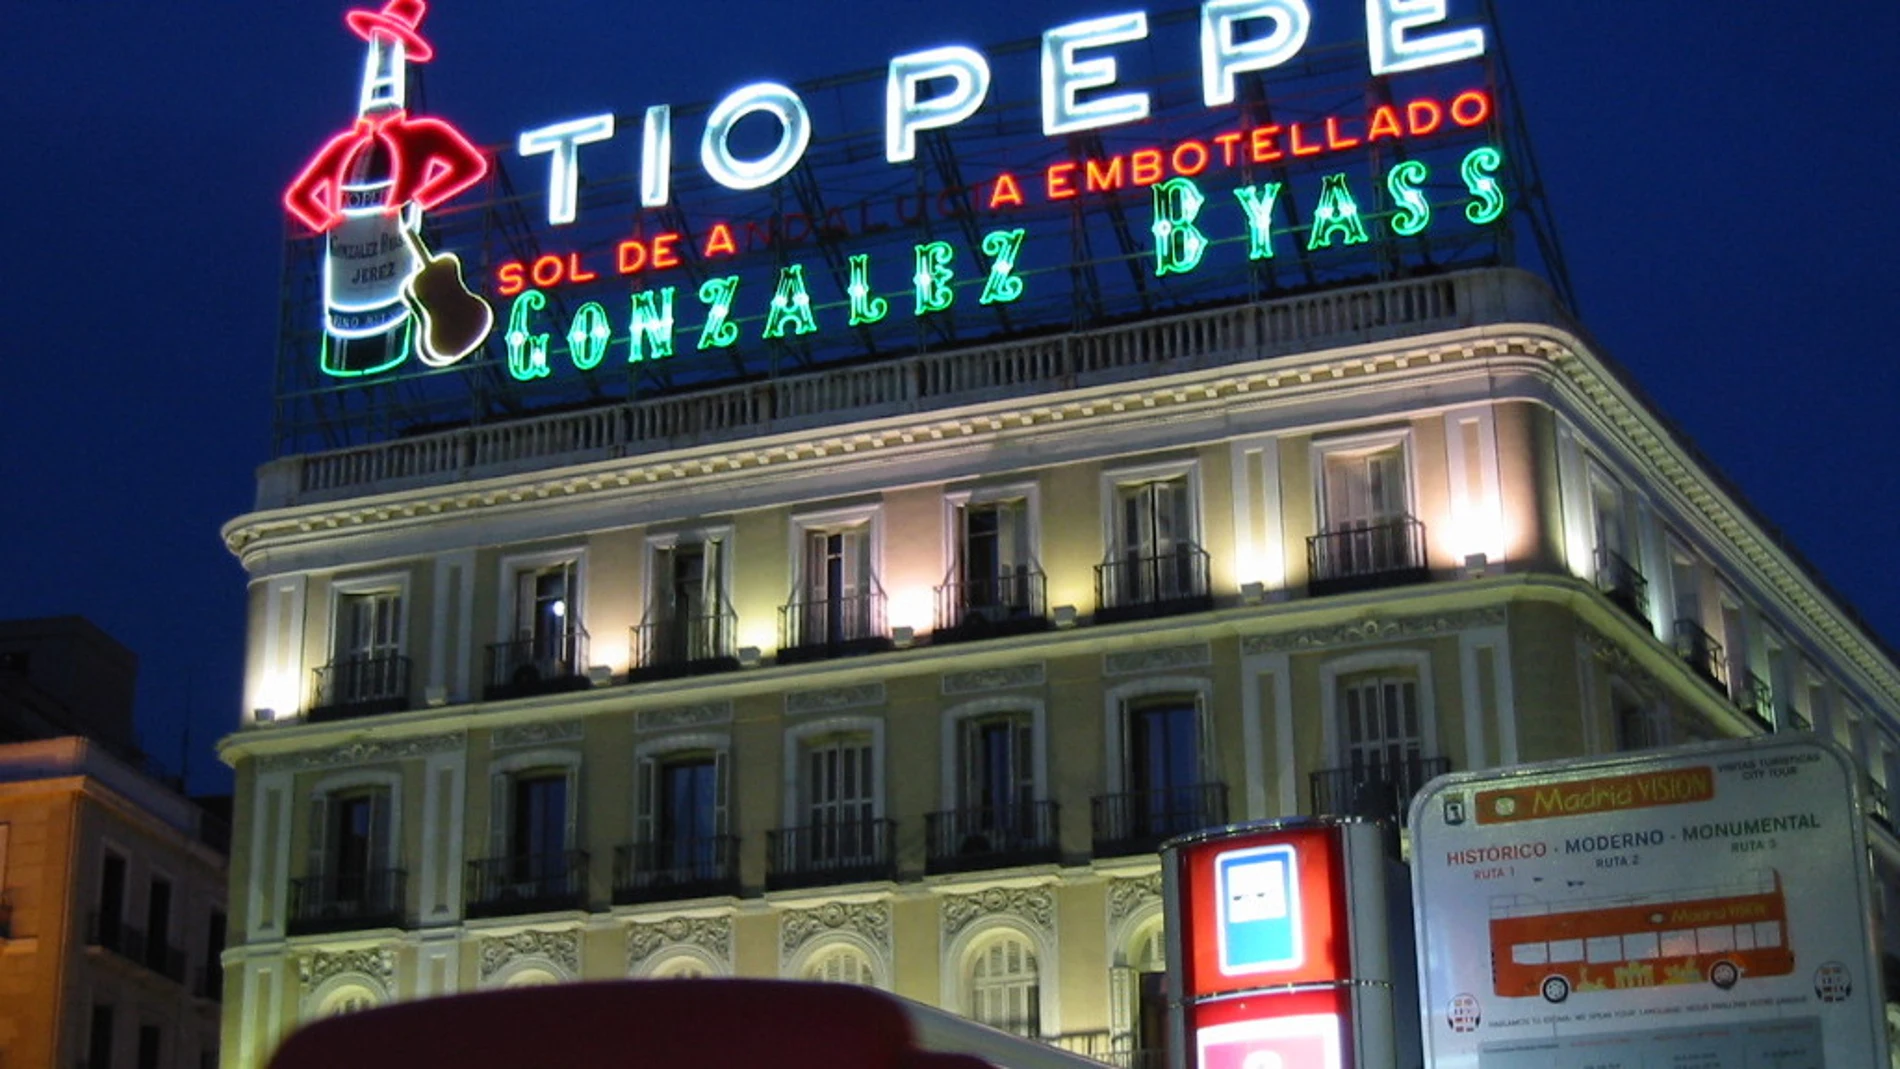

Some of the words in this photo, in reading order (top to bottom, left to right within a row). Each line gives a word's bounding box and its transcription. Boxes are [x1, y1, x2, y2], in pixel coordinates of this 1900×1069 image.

[518, 82, 812, 225] TIO
[884, 0, 1486, 163] PEPE
[498, 251, 595, 296] SOL
[618, 233, 679, 274] DE
[1046, 90, 1494, 201] EMBOTELLADO
[351, 261, 396, 285] JEREZ
[504, 229, 1026, 382] GONZALEZ
[1151, 147, 1505, 277] BYASS
[1742, 770, 1766, 781] CITY
[1769, 766, 1798, 778] TOUR
[1532, 782, 1633, 815] Madrid
[1637, 772, 1708, 802] VISION
[1565, 829, 1665, 855] MODERNO
[1682, 813, 1821, 842] MONUMENTAL
[1731, 840, 1764, 853] RUTA
[1474, 868, 1505, 880] RUTA
[1510, 866, 1516, 877] 1
[1596, 856, 1628, 868] RUTA
[1632, 854, 1640, 866] 2
